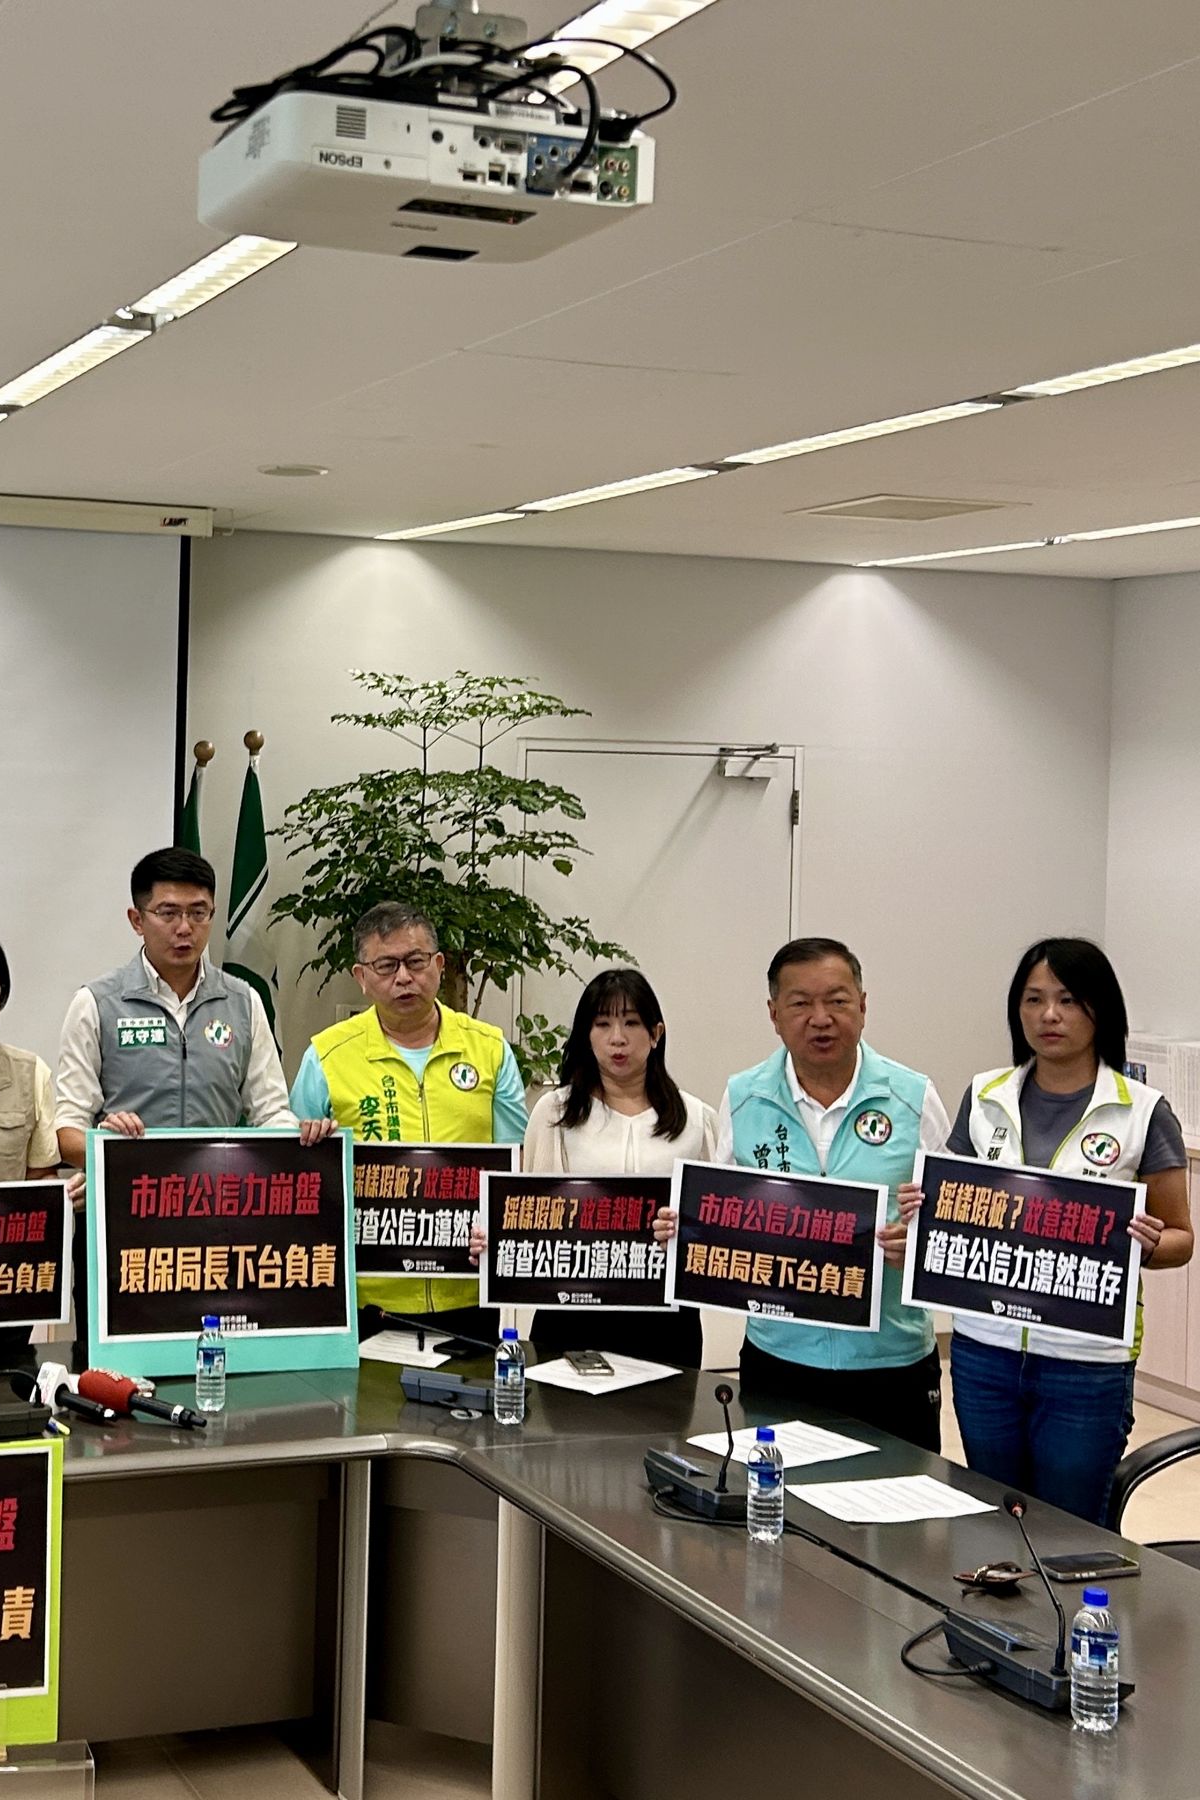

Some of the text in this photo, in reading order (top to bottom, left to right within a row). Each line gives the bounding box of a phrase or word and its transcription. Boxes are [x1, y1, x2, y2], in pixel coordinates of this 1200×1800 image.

[319, 151, 363, 168] EPSON
[753, 1143, 771, 1169] 曾
[130, 1171, 321, 1218] 市府公信力崩盤
[354, 1208, 480, 1247] 查公信力蕩然
[698, 1193, 857, 1245] 市府公信力崩盤
[119, 1243, 336, 1294] 環保局長下台負責
[496, 1239, 665, 1279] 稽查公信力蕩然無存
[684, 1243, 866, 1299] 環保局長下台負責
[924, 1229, 1123, 1306] 稽查公信力蕩然無存
